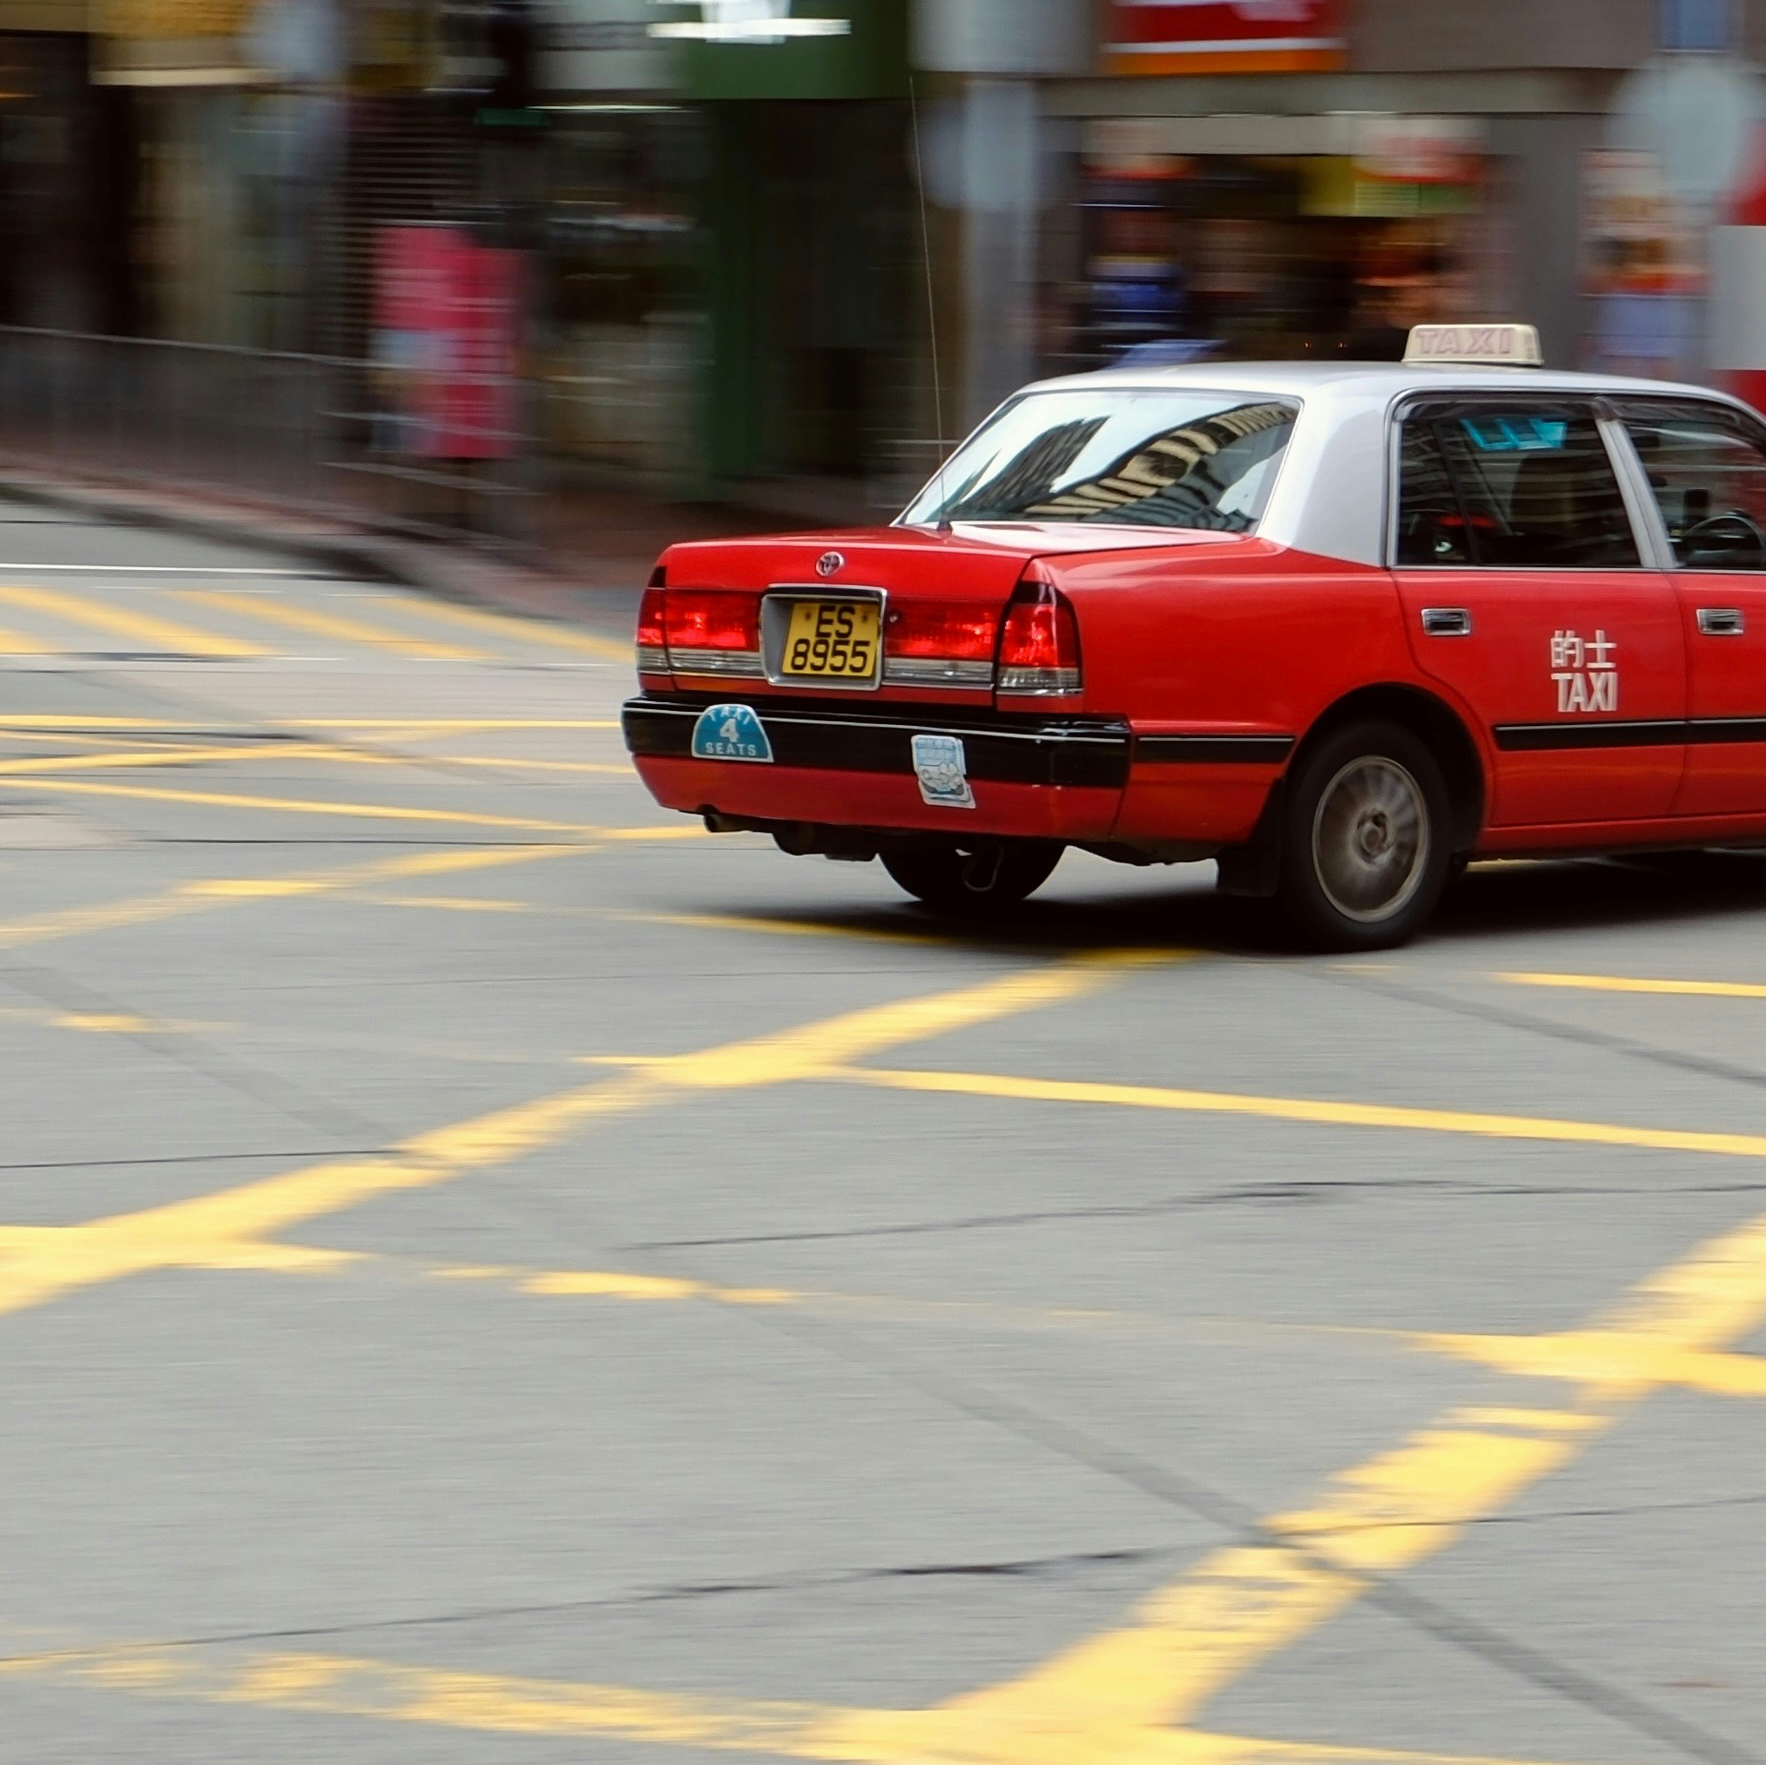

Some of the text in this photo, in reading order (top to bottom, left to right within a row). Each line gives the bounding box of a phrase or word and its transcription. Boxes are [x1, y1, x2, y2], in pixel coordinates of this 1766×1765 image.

[1414, 327, 1514, 355] TAXI
[815, 605, 855, 638] ES
[791, 638, 870, 673] 8955
[1550, 629, 1617, 668] 的士
[1551, 671, 1619, 713] TAXI
[707, 705, 752, 725] TAXI
[720, 718, 740, 743] 4
[705, 742, 757, 756] SEATS
